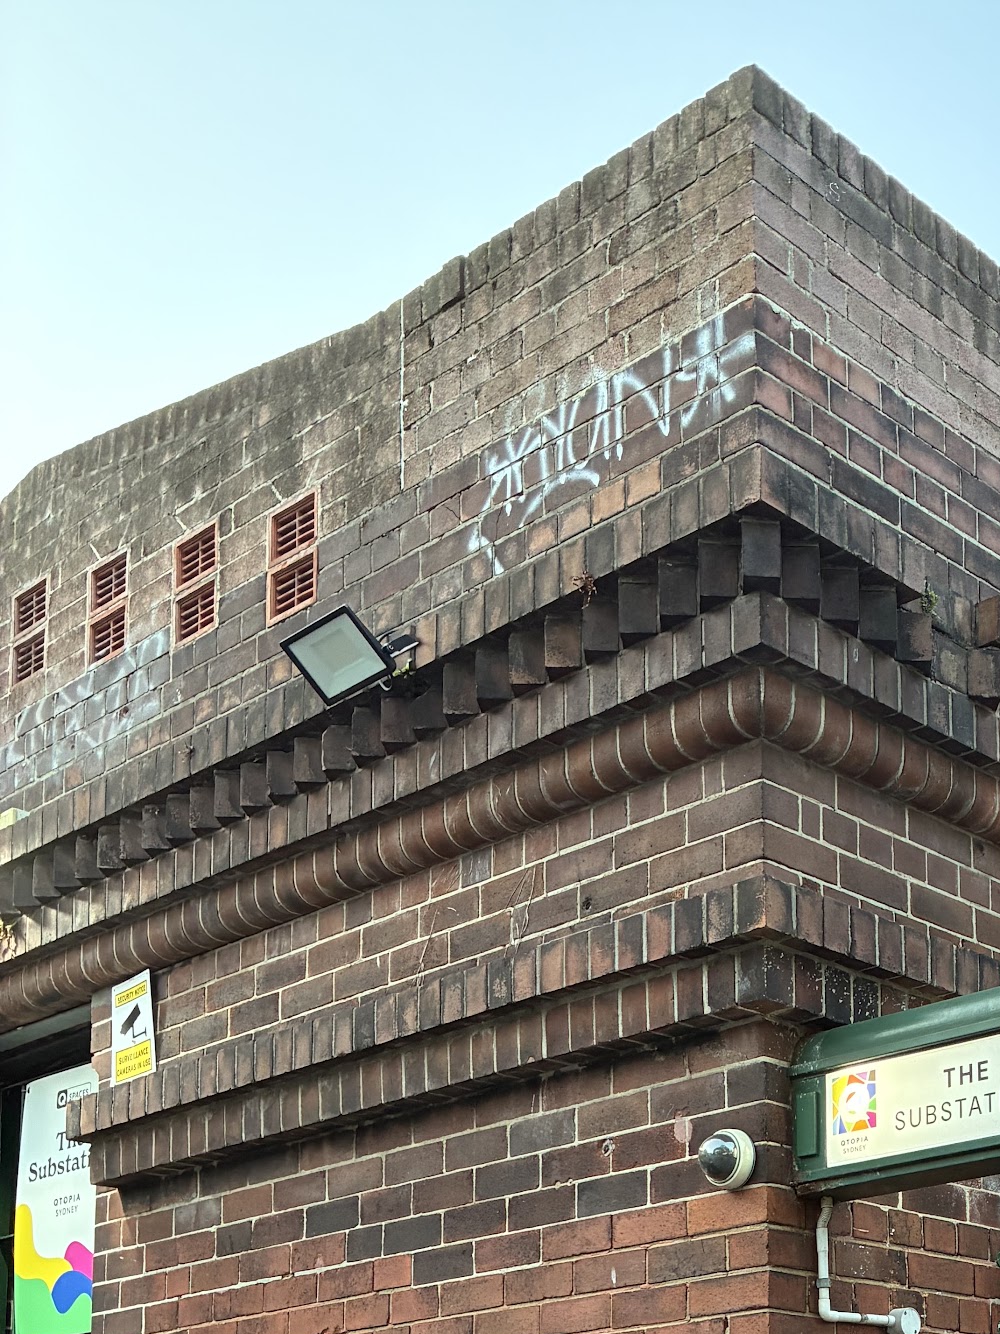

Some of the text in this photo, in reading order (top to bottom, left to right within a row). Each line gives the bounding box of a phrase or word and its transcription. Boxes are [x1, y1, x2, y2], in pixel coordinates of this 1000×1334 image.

[117, 1064, 136, 1076] CAMERAS
[943, 1060, 989, 1088] THE
[840, 1136, 869, 1146] QTOPIA
[842, 1144, 866, 1154] SYDNEY
[54, 1193, 81, 1206] QTOPIA
[55, 1204, 78, 1217] SYDNEY
